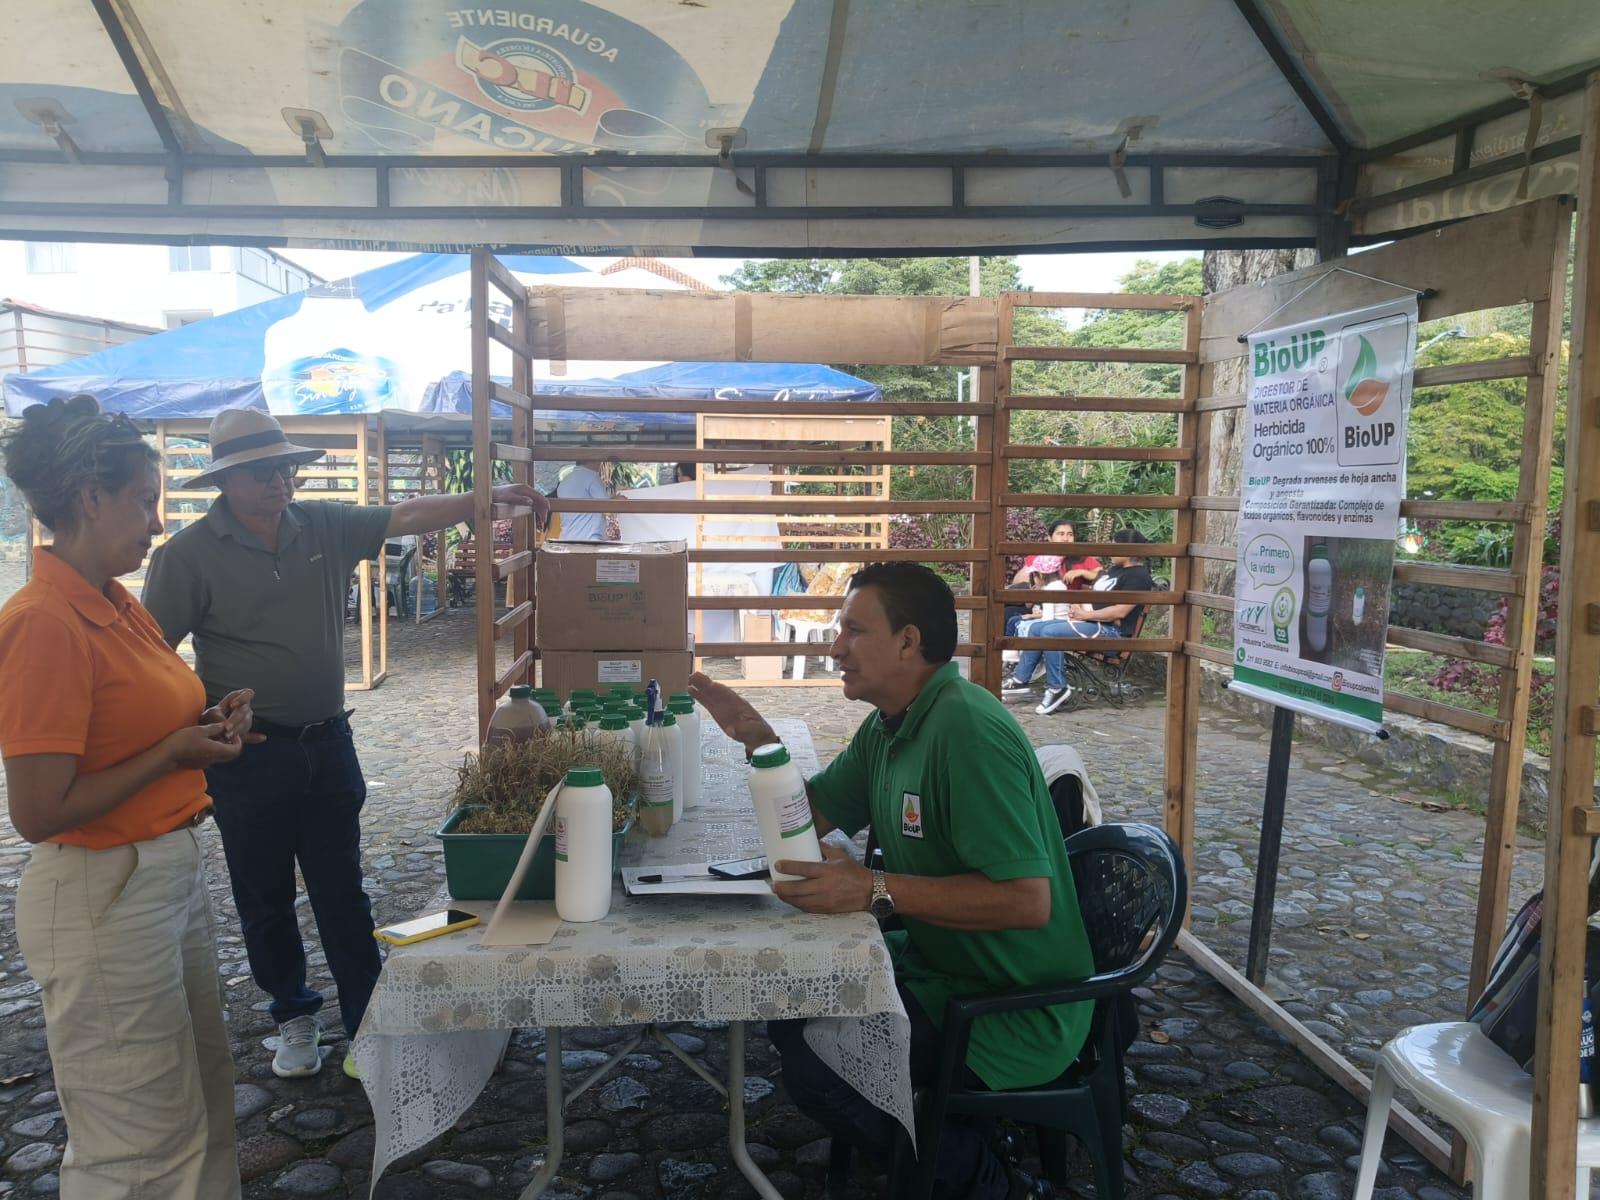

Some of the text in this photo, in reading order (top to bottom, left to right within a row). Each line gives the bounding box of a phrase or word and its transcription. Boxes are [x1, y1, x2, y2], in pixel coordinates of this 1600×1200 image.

[1254, 330, 1326, 378] BioUP
[1253, 393, 1335, 416] MATERIA ORGÁNICA
[1254, 419, 1305, 437] Herbicida
[1344, 422, 1395, 449] BioUP
[1253, 437, 1335, 461] Orgánico 100%
[1248, 472, 1397, 487] BioUP Degrada arvenses de hoja ancha
[1338, 500, 1373, 511] Complejo
[1374, 501, 1384, 511] de
[1343, 513, 1374, 523] enzimas
[1259, 545, 1290, 559] Primero
[1250, 561, 1275, 574] la vida
[904, 823, 921, 834] BioUP
